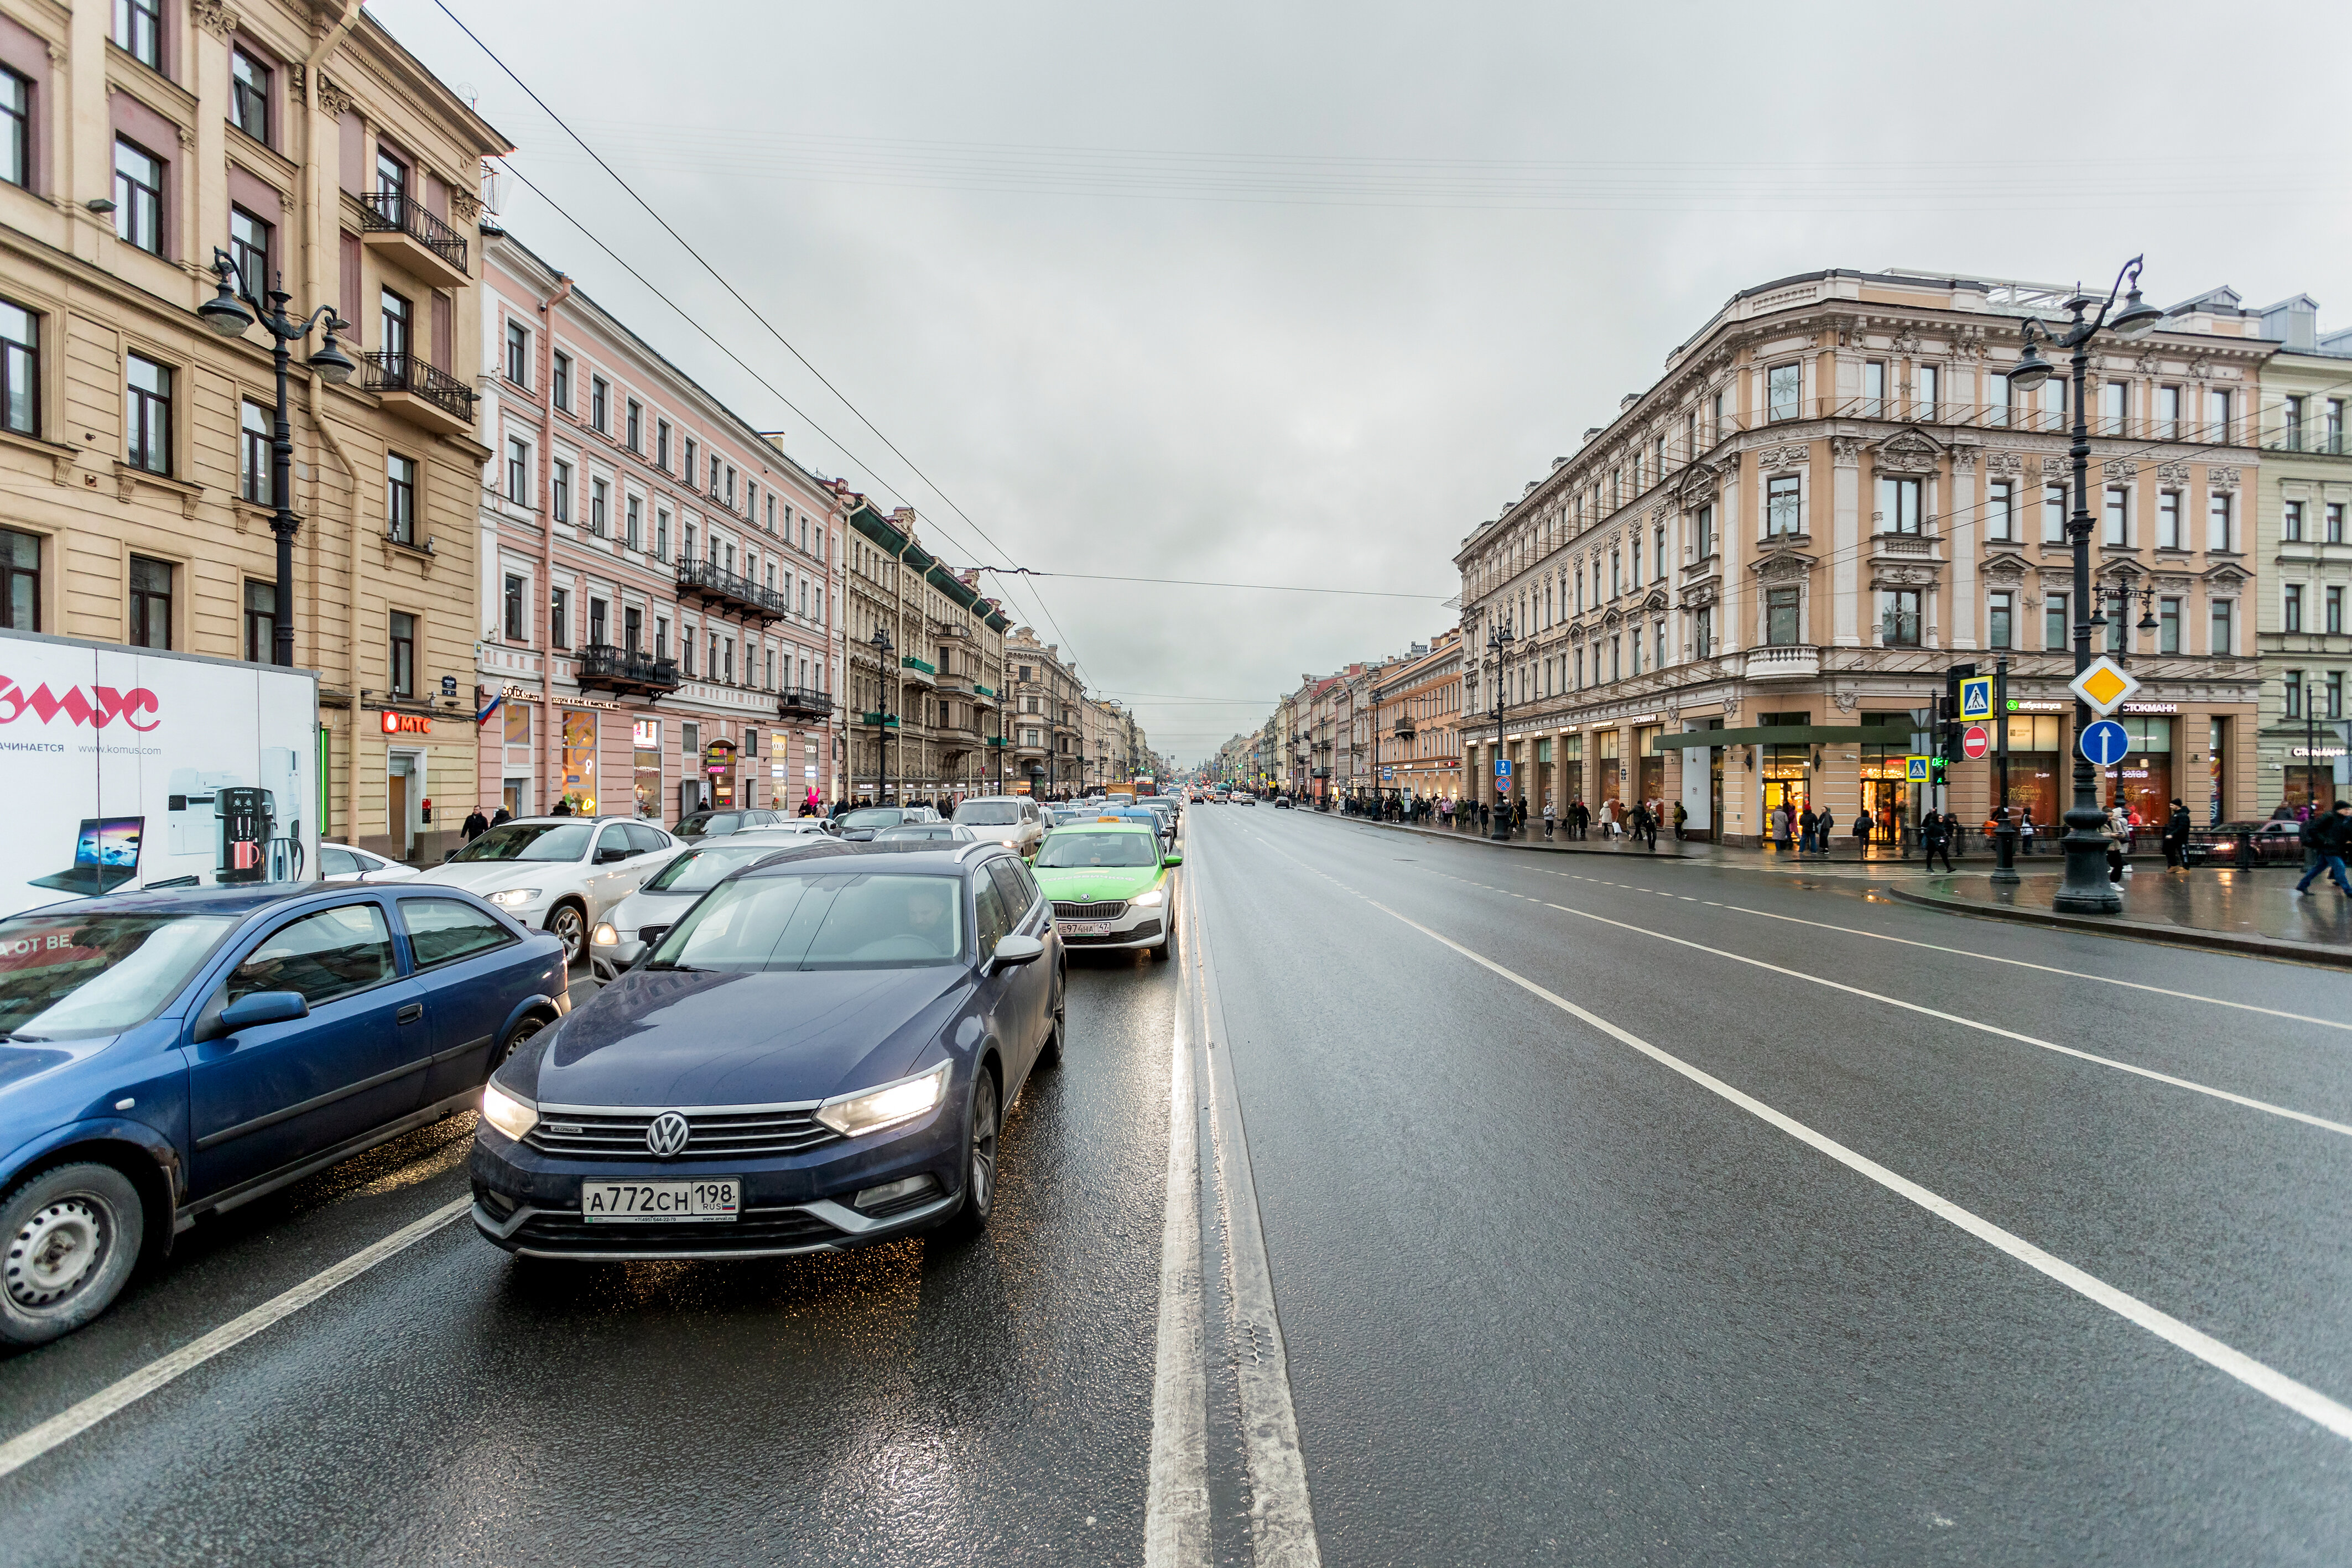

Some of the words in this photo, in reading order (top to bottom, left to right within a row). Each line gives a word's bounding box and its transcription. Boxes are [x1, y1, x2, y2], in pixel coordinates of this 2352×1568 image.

[2122, 704, 2177, 712] СТОКМАНН
[1632, 713, 1658, 723] СТОКМАНН
[400, 716, 431, 733] МТС
[78, 744, 162, 755] www.komus.com
[1062, 924, 1094, 933] Е974НА
[590, 1186, 688, 1211] А772СН
[694, 1184, 732, 1204] 198
